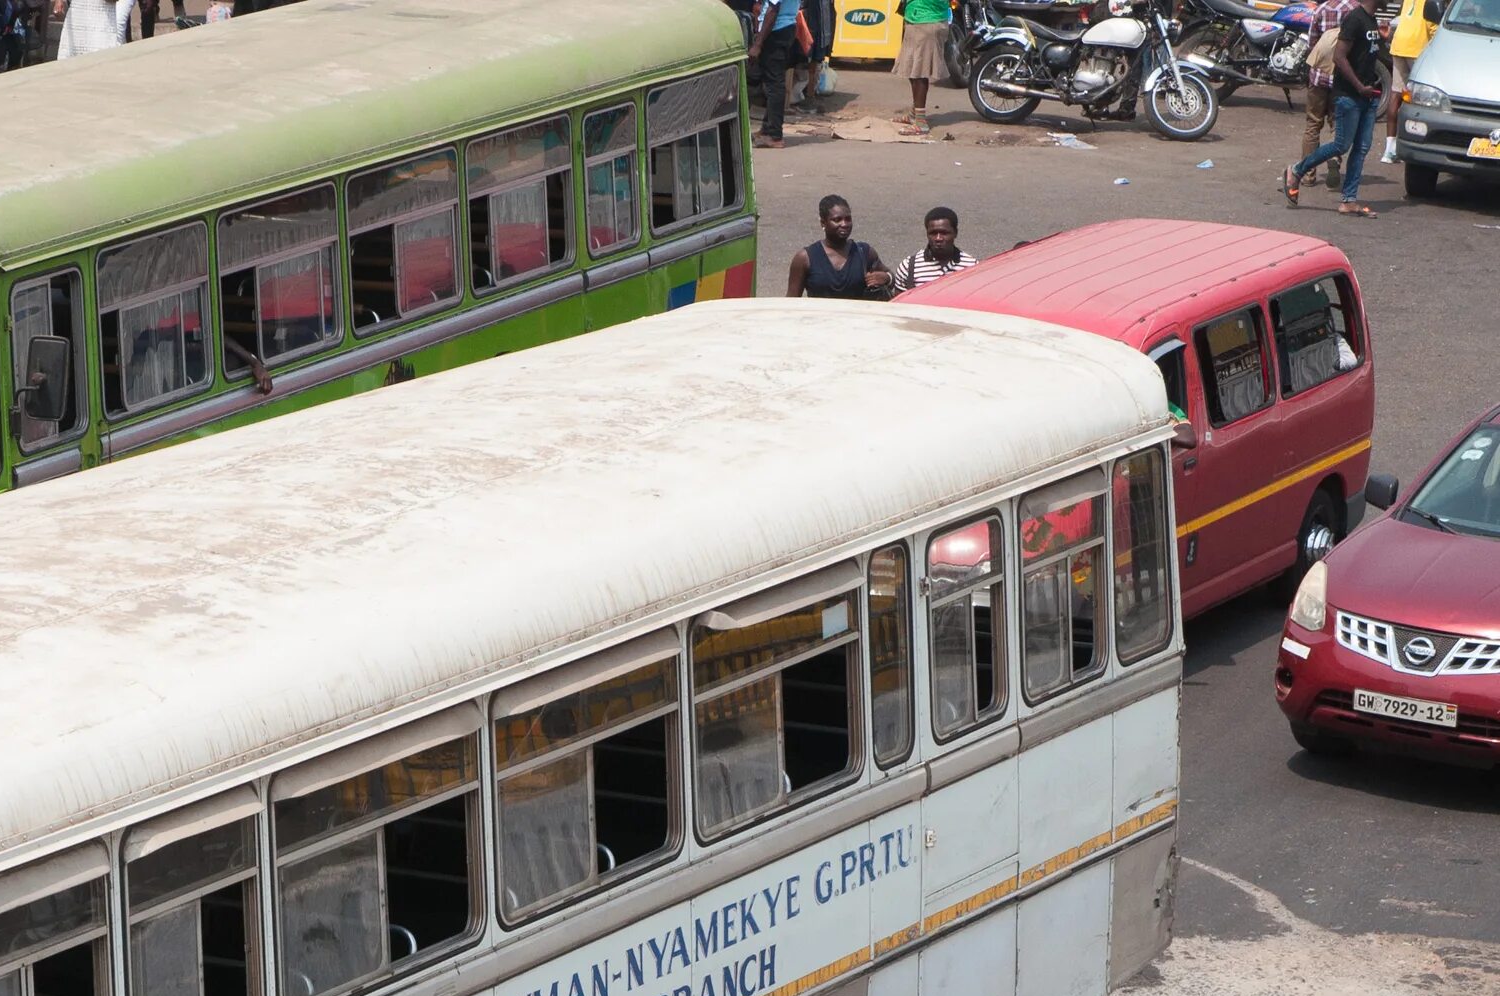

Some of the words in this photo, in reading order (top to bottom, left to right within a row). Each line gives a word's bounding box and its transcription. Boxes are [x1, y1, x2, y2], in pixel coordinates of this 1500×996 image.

[851, 12, 879, 22] MTN
[1357, 693, 1376, 709] GW
[1383, 698, 1444, 722] 7929-12
